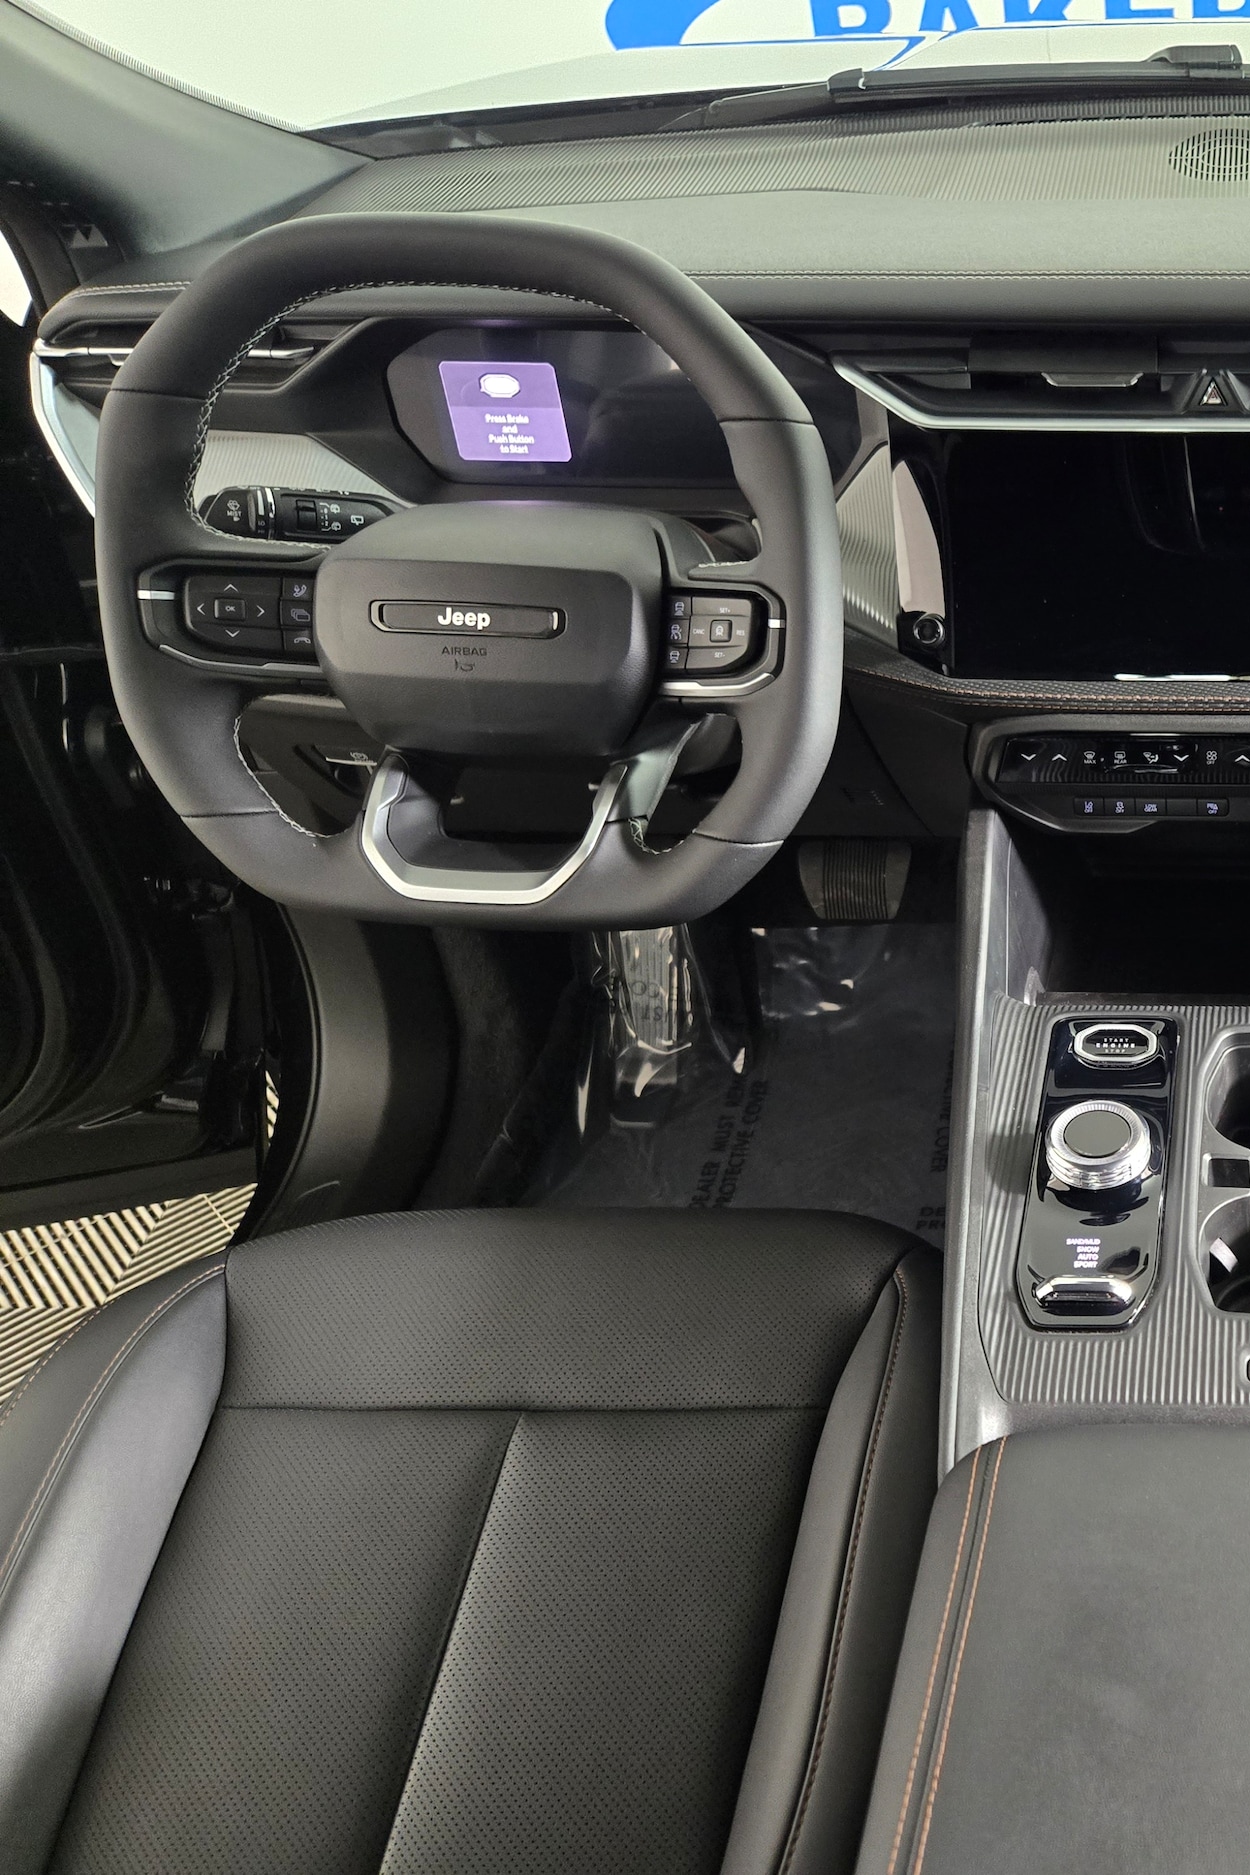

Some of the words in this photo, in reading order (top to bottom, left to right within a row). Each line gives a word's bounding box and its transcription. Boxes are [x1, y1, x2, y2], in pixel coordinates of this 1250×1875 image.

[507, 413, 529, 423] Brake
[502, 424, 518, 433] and
[488, 433, 508, 443] Push
[508, 433, 535, 444] Button
[500, 444, 509, 453] to
[509, 444, 529, 453] Start
[437, 607, 491, 630] Jeep
[441, 645, 488, 656] AIRBAG
[711, 1114, 735, 1151] MUST
[1077, 1253, 1099, 1261] AUTO
[1073, 1260, 1098, 1268] SPORT
